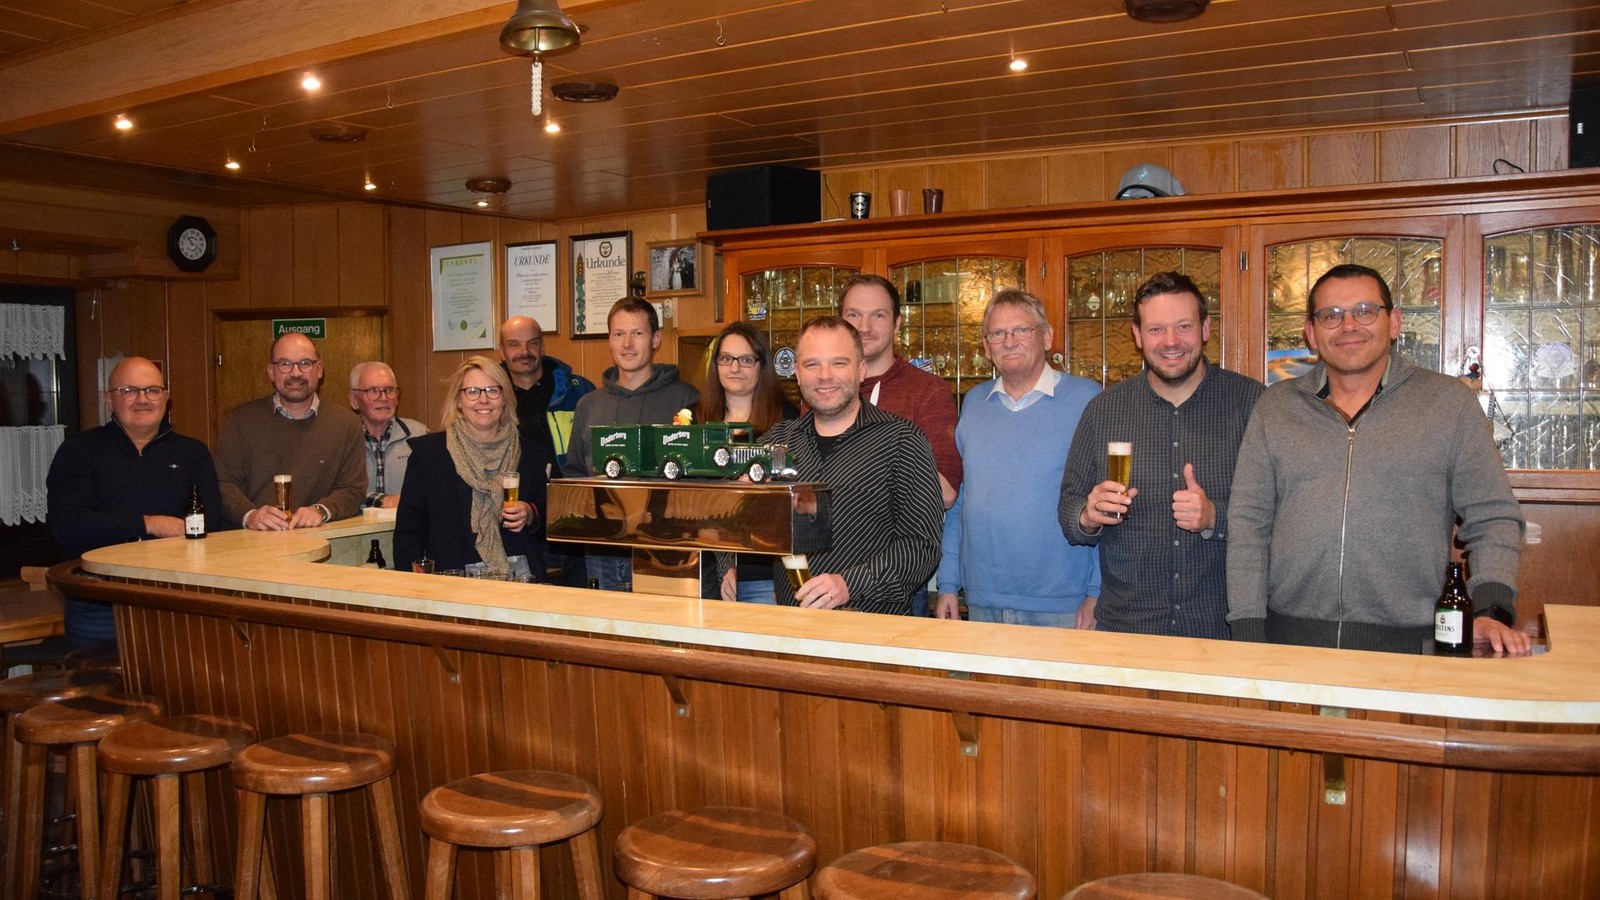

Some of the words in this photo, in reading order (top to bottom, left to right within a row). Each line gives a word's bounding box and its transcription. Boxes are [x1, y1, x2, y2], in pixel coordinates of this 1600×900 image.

[514, 254, 550, 267] URKUNDE
[586, 256, 626, 269] Urkunde
[278, 324, 320, 335] Ausgang
[1435, 624, 1455, 633] ELTINS
